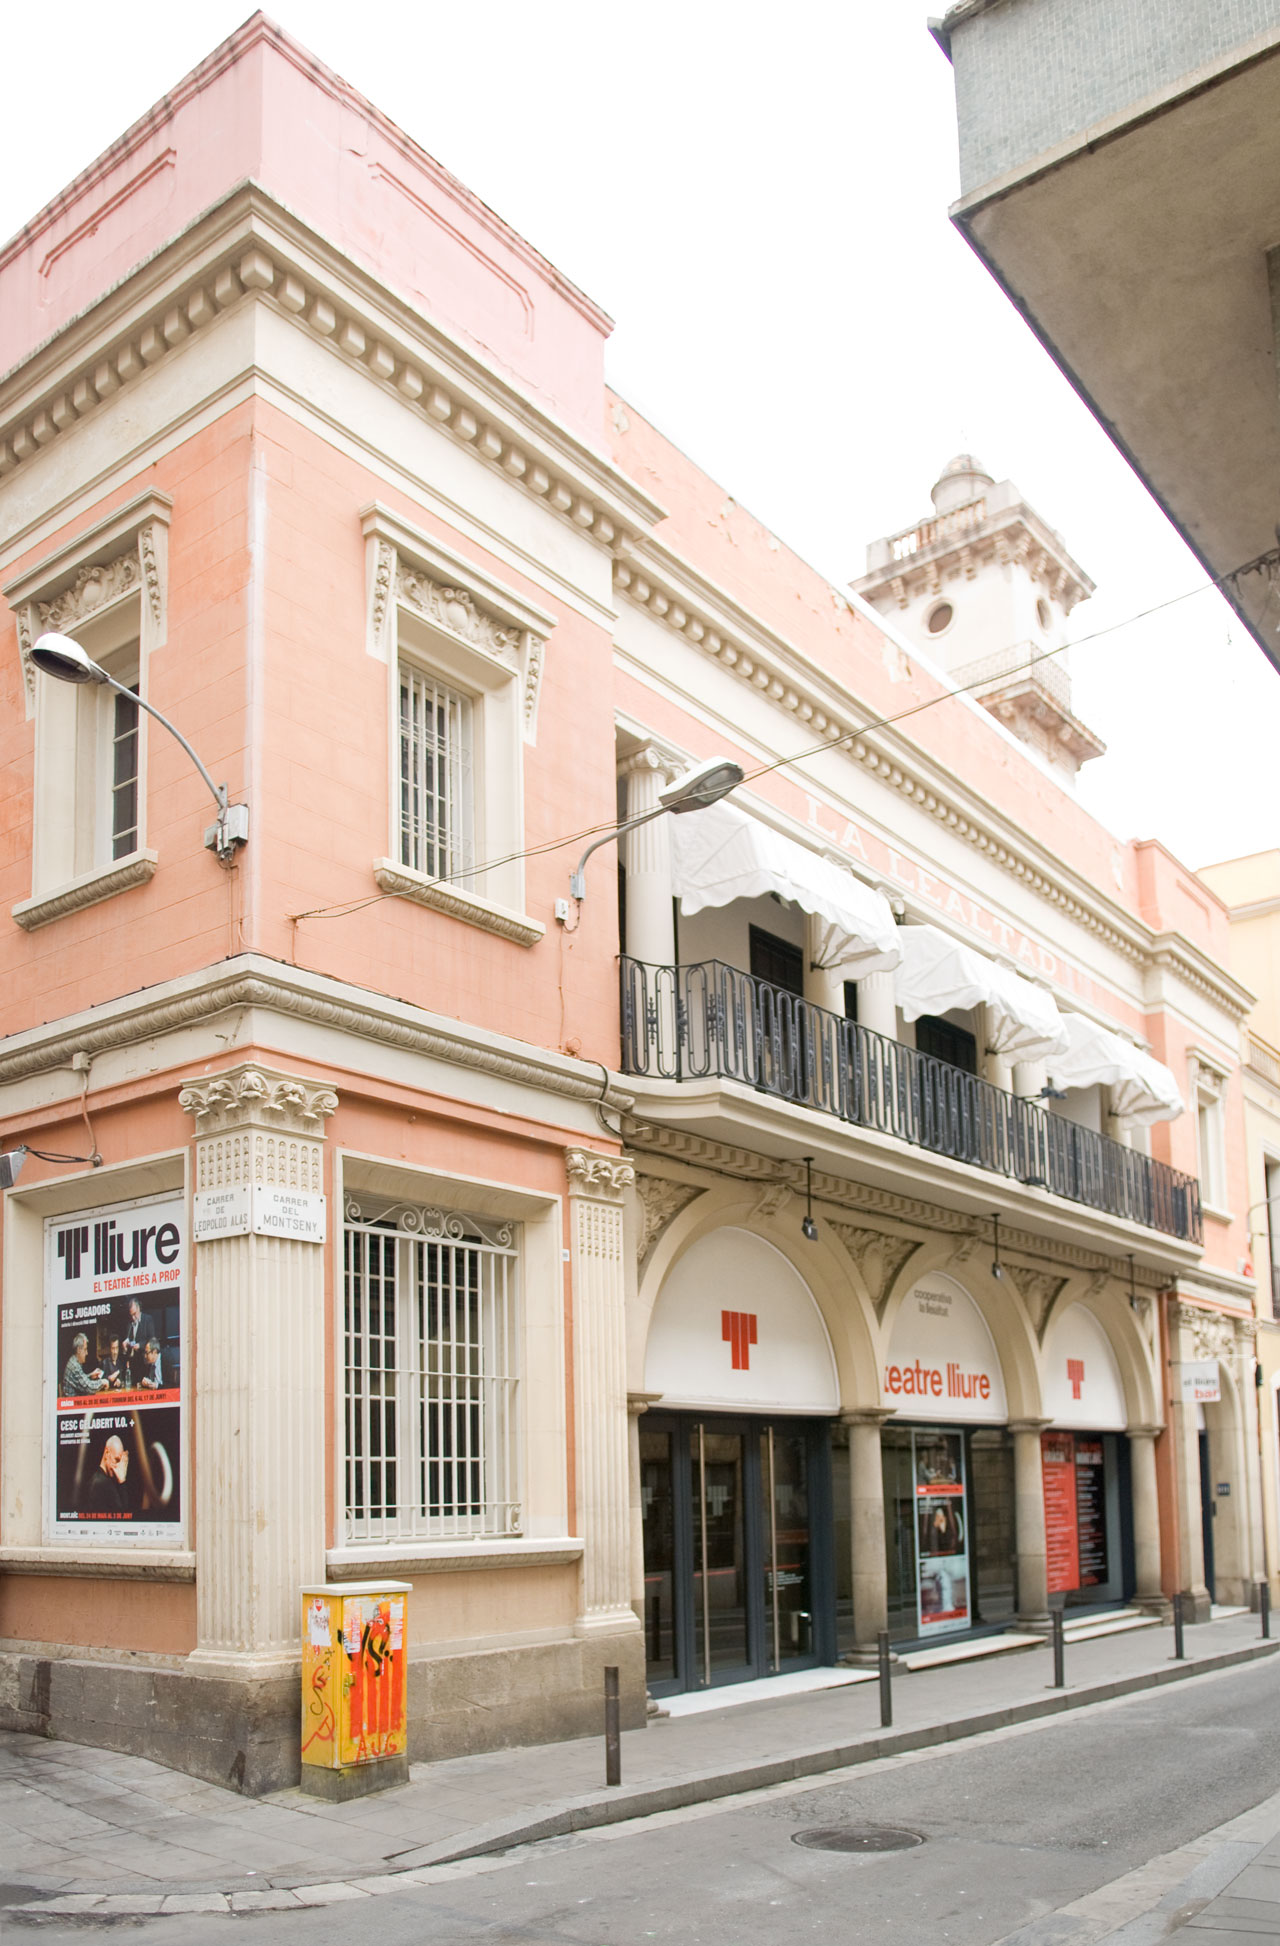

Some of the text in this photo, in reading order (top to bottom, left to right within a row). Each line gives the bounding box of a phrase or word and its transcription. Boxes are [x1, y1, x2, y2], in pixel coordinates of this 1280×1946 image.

[207, 1193, 235, 1206] CARRER
[273, 1194, 308, 1207] CARRER
[215, 1206, 225, 1214] DE
[282, 1206, 299, 1216] DEL
[194, 1213, 248, 1232] LEOPOLDO ALAS
[263, 1214, 318, 1232] MONTSENY
[94, 1220, 180, 1276] lliure
[93, 1281, 102, 1293] EL
[103, 1276, 131, 1291] TEATRE
[151, 1273, 157, 1284] A
[159, 1268, 181, 1282] PROP
[61, 1303, 111, 1320] ELS JUGADORS
[946, 1362, 991, 1400] lliure
[61, 1420, 78, 1431] CESC
[79, 1417, 114, 1430] GELABERT
[115, 1416, 128, 1428] V.O.
